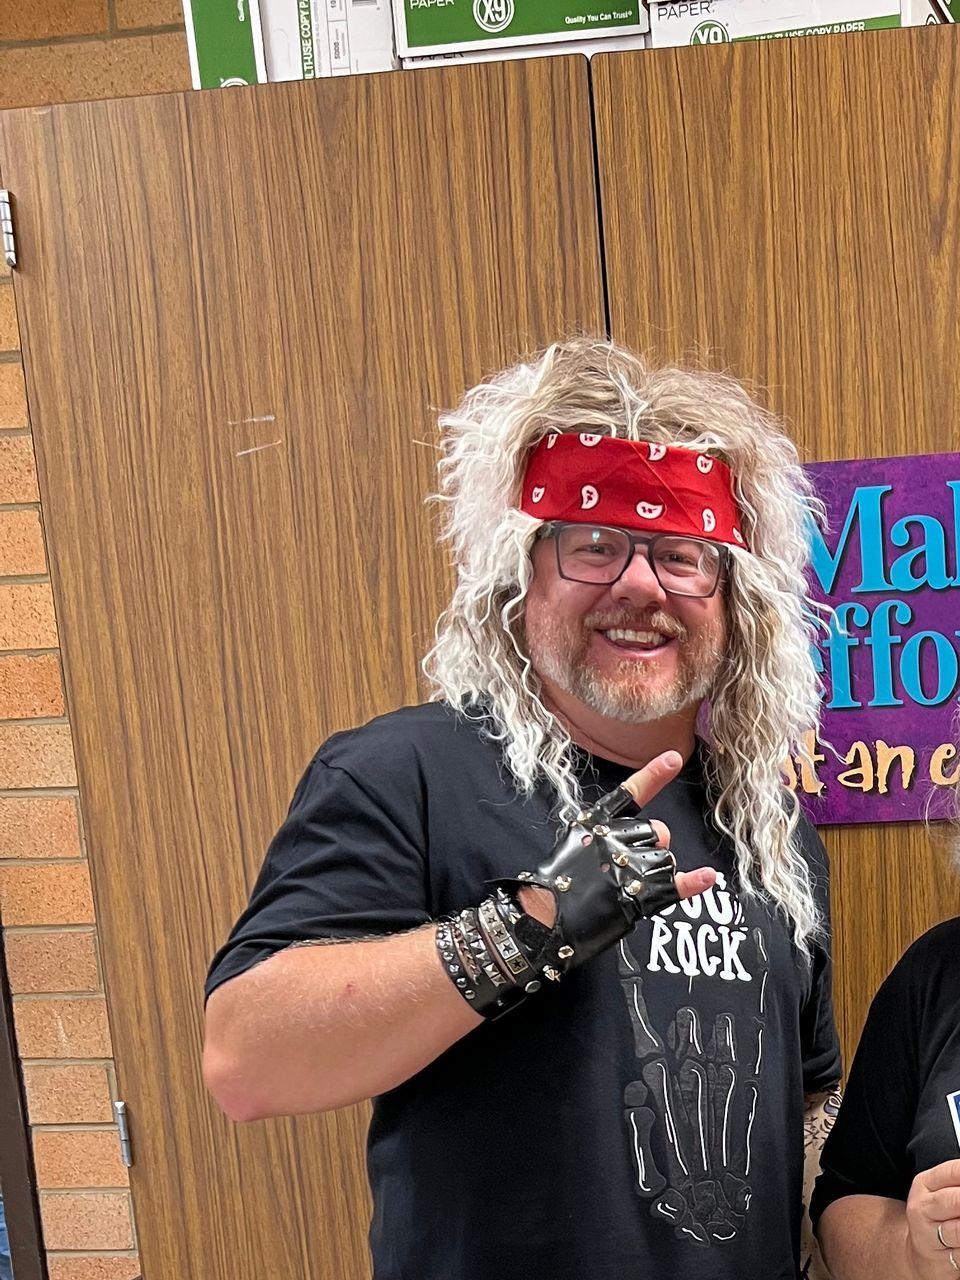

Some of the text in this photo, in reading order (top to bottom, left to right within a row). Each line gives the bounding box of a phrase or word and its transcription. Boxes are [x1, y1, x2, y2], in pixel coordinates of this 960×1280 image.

[587, 14, 599, 22] You
[600, 13, 612, 21] Can
[657, 1, 711, 21] PAPER
[837, 739, 915, 794] an
[646, 914, 753, 982] ROCK
